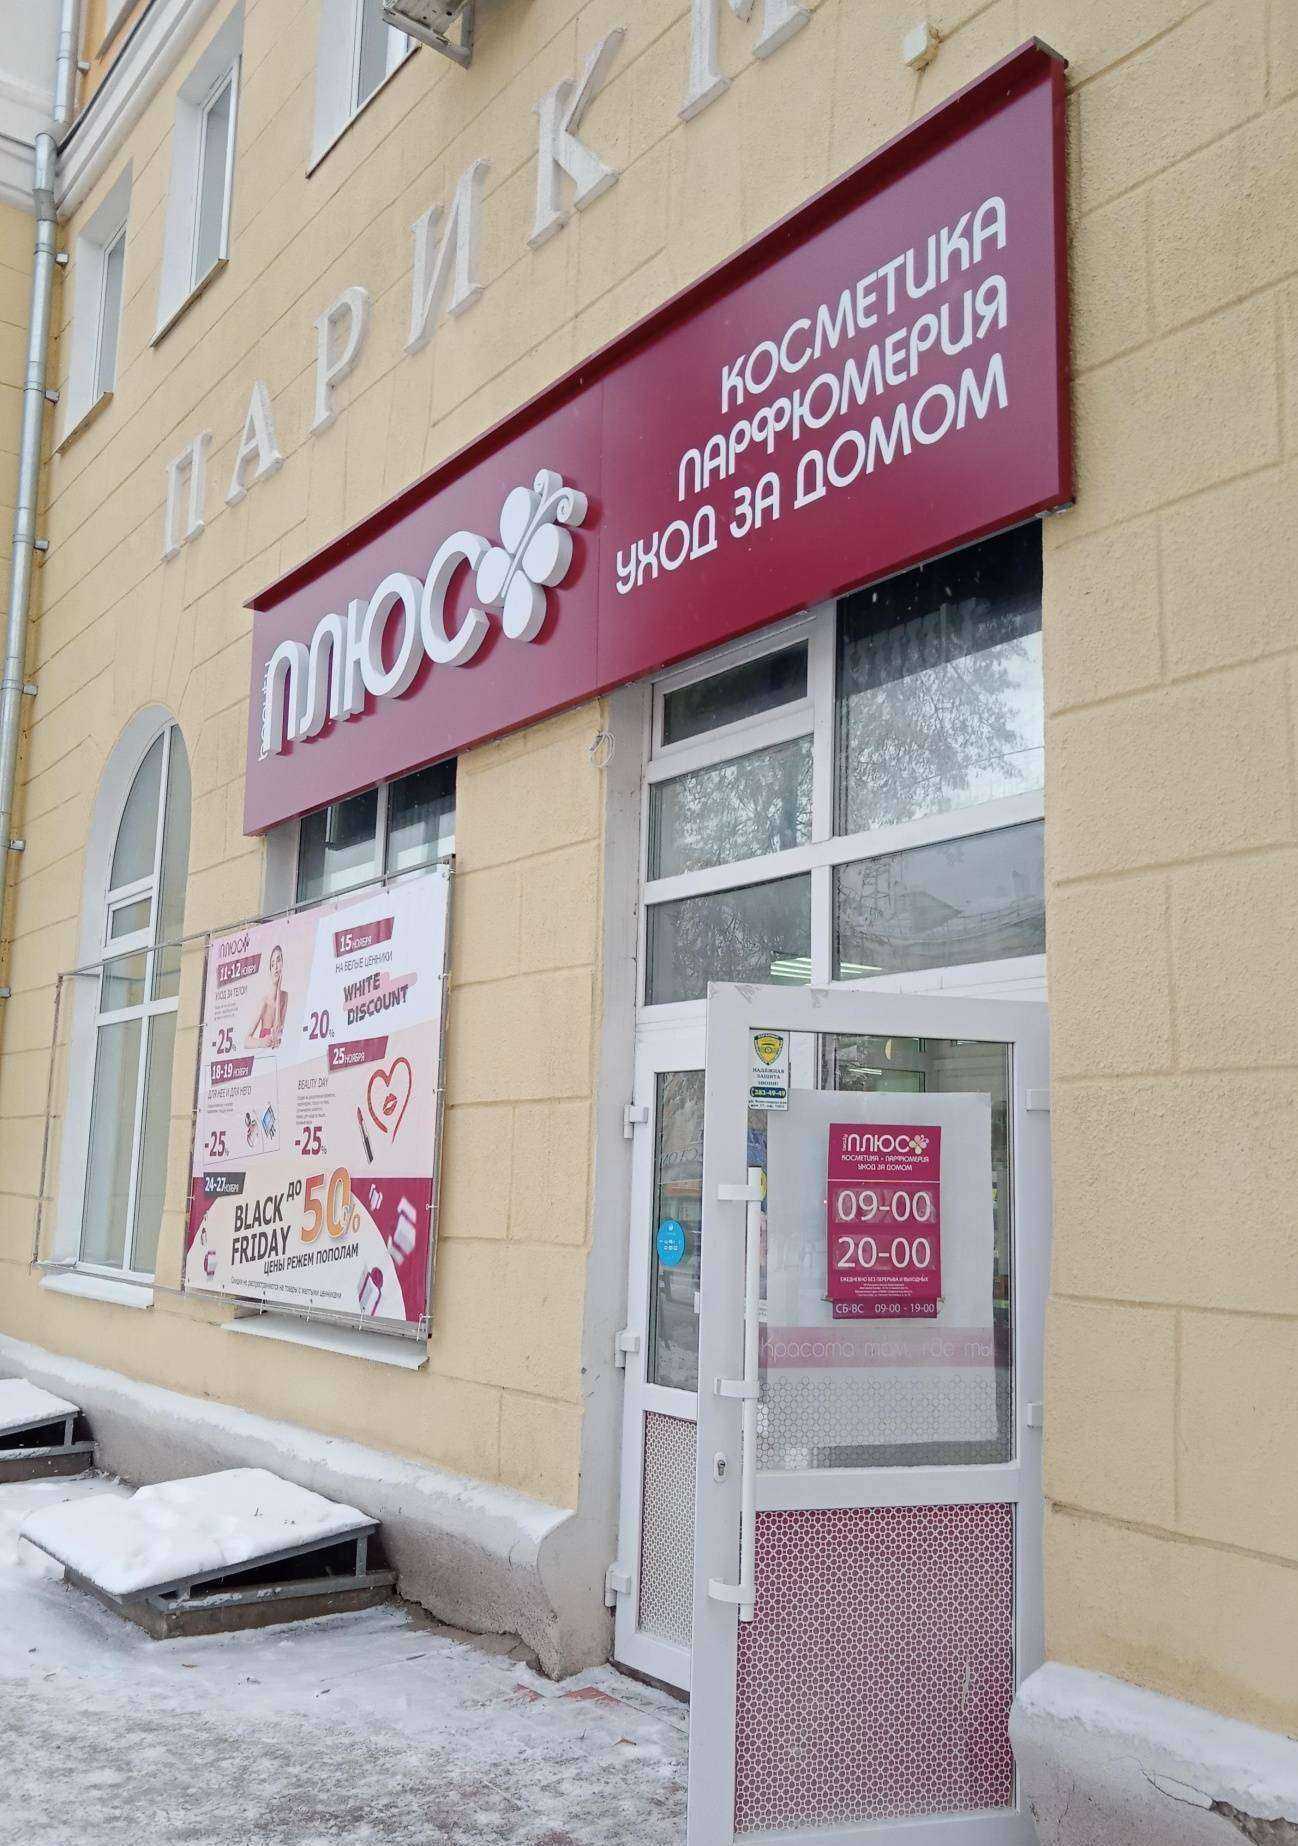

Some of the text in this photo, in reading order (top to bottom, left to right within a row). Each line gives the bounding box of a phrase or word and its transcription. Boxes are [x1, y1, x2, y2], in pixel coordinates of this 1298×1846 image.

[721, 196, 1007, 414] КОСМЕТИКА
[678, 274, 1008, 502] ПАРФЮМЕРИЯ
[616, 352, 1008, 595] УХОД ЗА ДОМОМ
[262, 530, 491, 755] ПЛЮС
[340, 934, 352, 951] 15
[219, 962, 241, 981] 11-12
[335, 962, 344, 973] НА
[364, 951, 392, 967] ЦЕННИКИ
[343, 972, 381, 1003] WHITE
[347, 984, 409, 1026] DISCOUNT
[303, 1009, 335, 1040] -20%
[332, 1047, 346, 1065] 25
[211, 1063, 233, 1080] 18-19
[298, 1077, 328, 1090] BEAUTY DAY
[294, 1126, 328, 1156] -25%
[847, 1133, 910, 1153] ПЛЮС
[841, 1154, 930, 1163] КОСМЕТИКА ПАРФЮМЕРИЯ
[857, 1163, 876, 1171] УХОД
[886, 1164, 913, 1172] ДОМОМ
[204, 1177, 225, 1192] 24-27
[287, 1179, 302, 1201] ДО
[234, 1193, 285, 1232] BLACK
[837, 1190, 931, 1222] 09-00
[231, 1225, 291, 1265] FRIDAY
[837, 1236, 931, 1269] 20-00
[264, 1243, 359, 1276] ЦЕНЫ РЕЖЕМ ПОПОЛАМ
[874, 1303, 901, 1313] 09-00
[910, 1303, 935, 1313] 19-00
[761, 1335, 855, 1362] Красота
